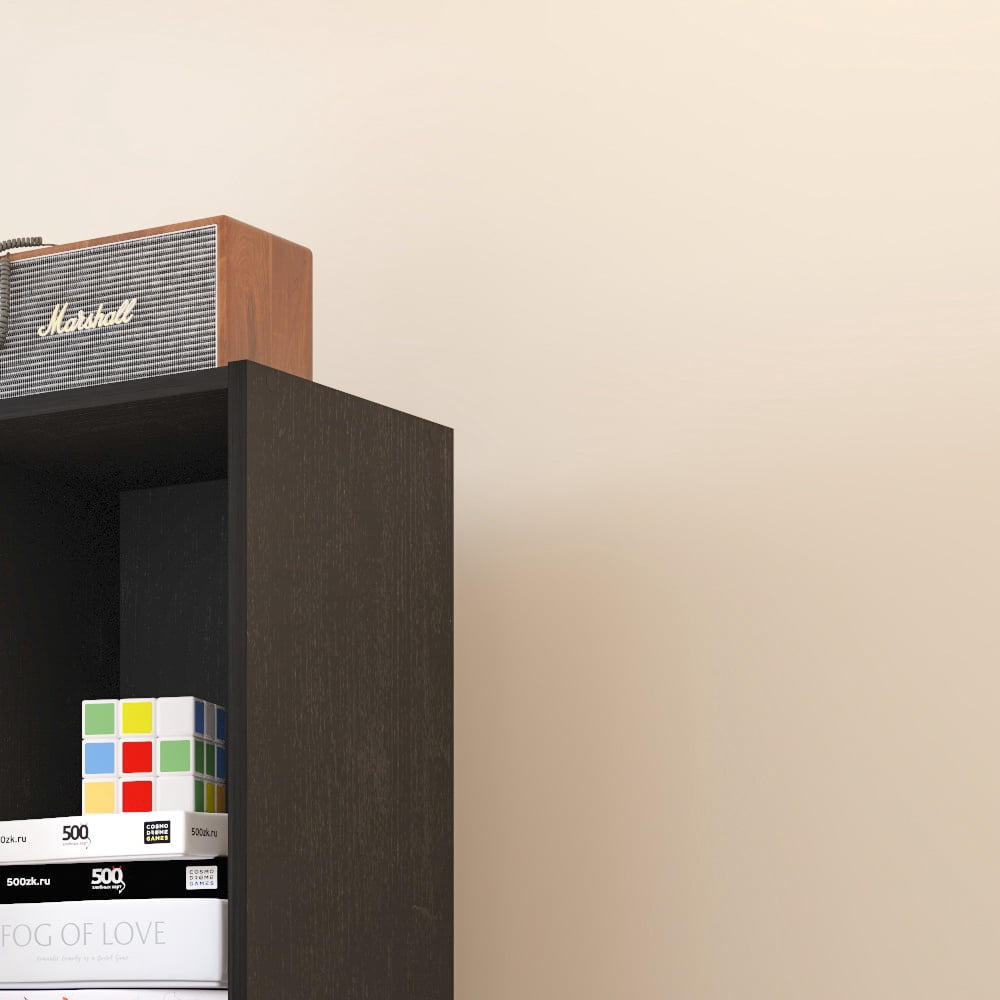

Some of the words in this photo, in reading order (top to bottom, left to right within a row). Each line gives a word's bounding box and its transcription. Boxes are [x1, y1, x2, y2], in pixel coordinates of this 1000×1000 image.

[37, 298, 138, 337] Marshall
[62, 825, 88, 840] 500
[192, 828, 217, 837] 500zk.ru
[7, 877, 50, 886] 500zk.ru
[91, 867, 122, 885] 500
[1, 922, 52, 947] FOG
[61, 923, 94, 946] OF
[102, 921, 166, 945] LOVE
